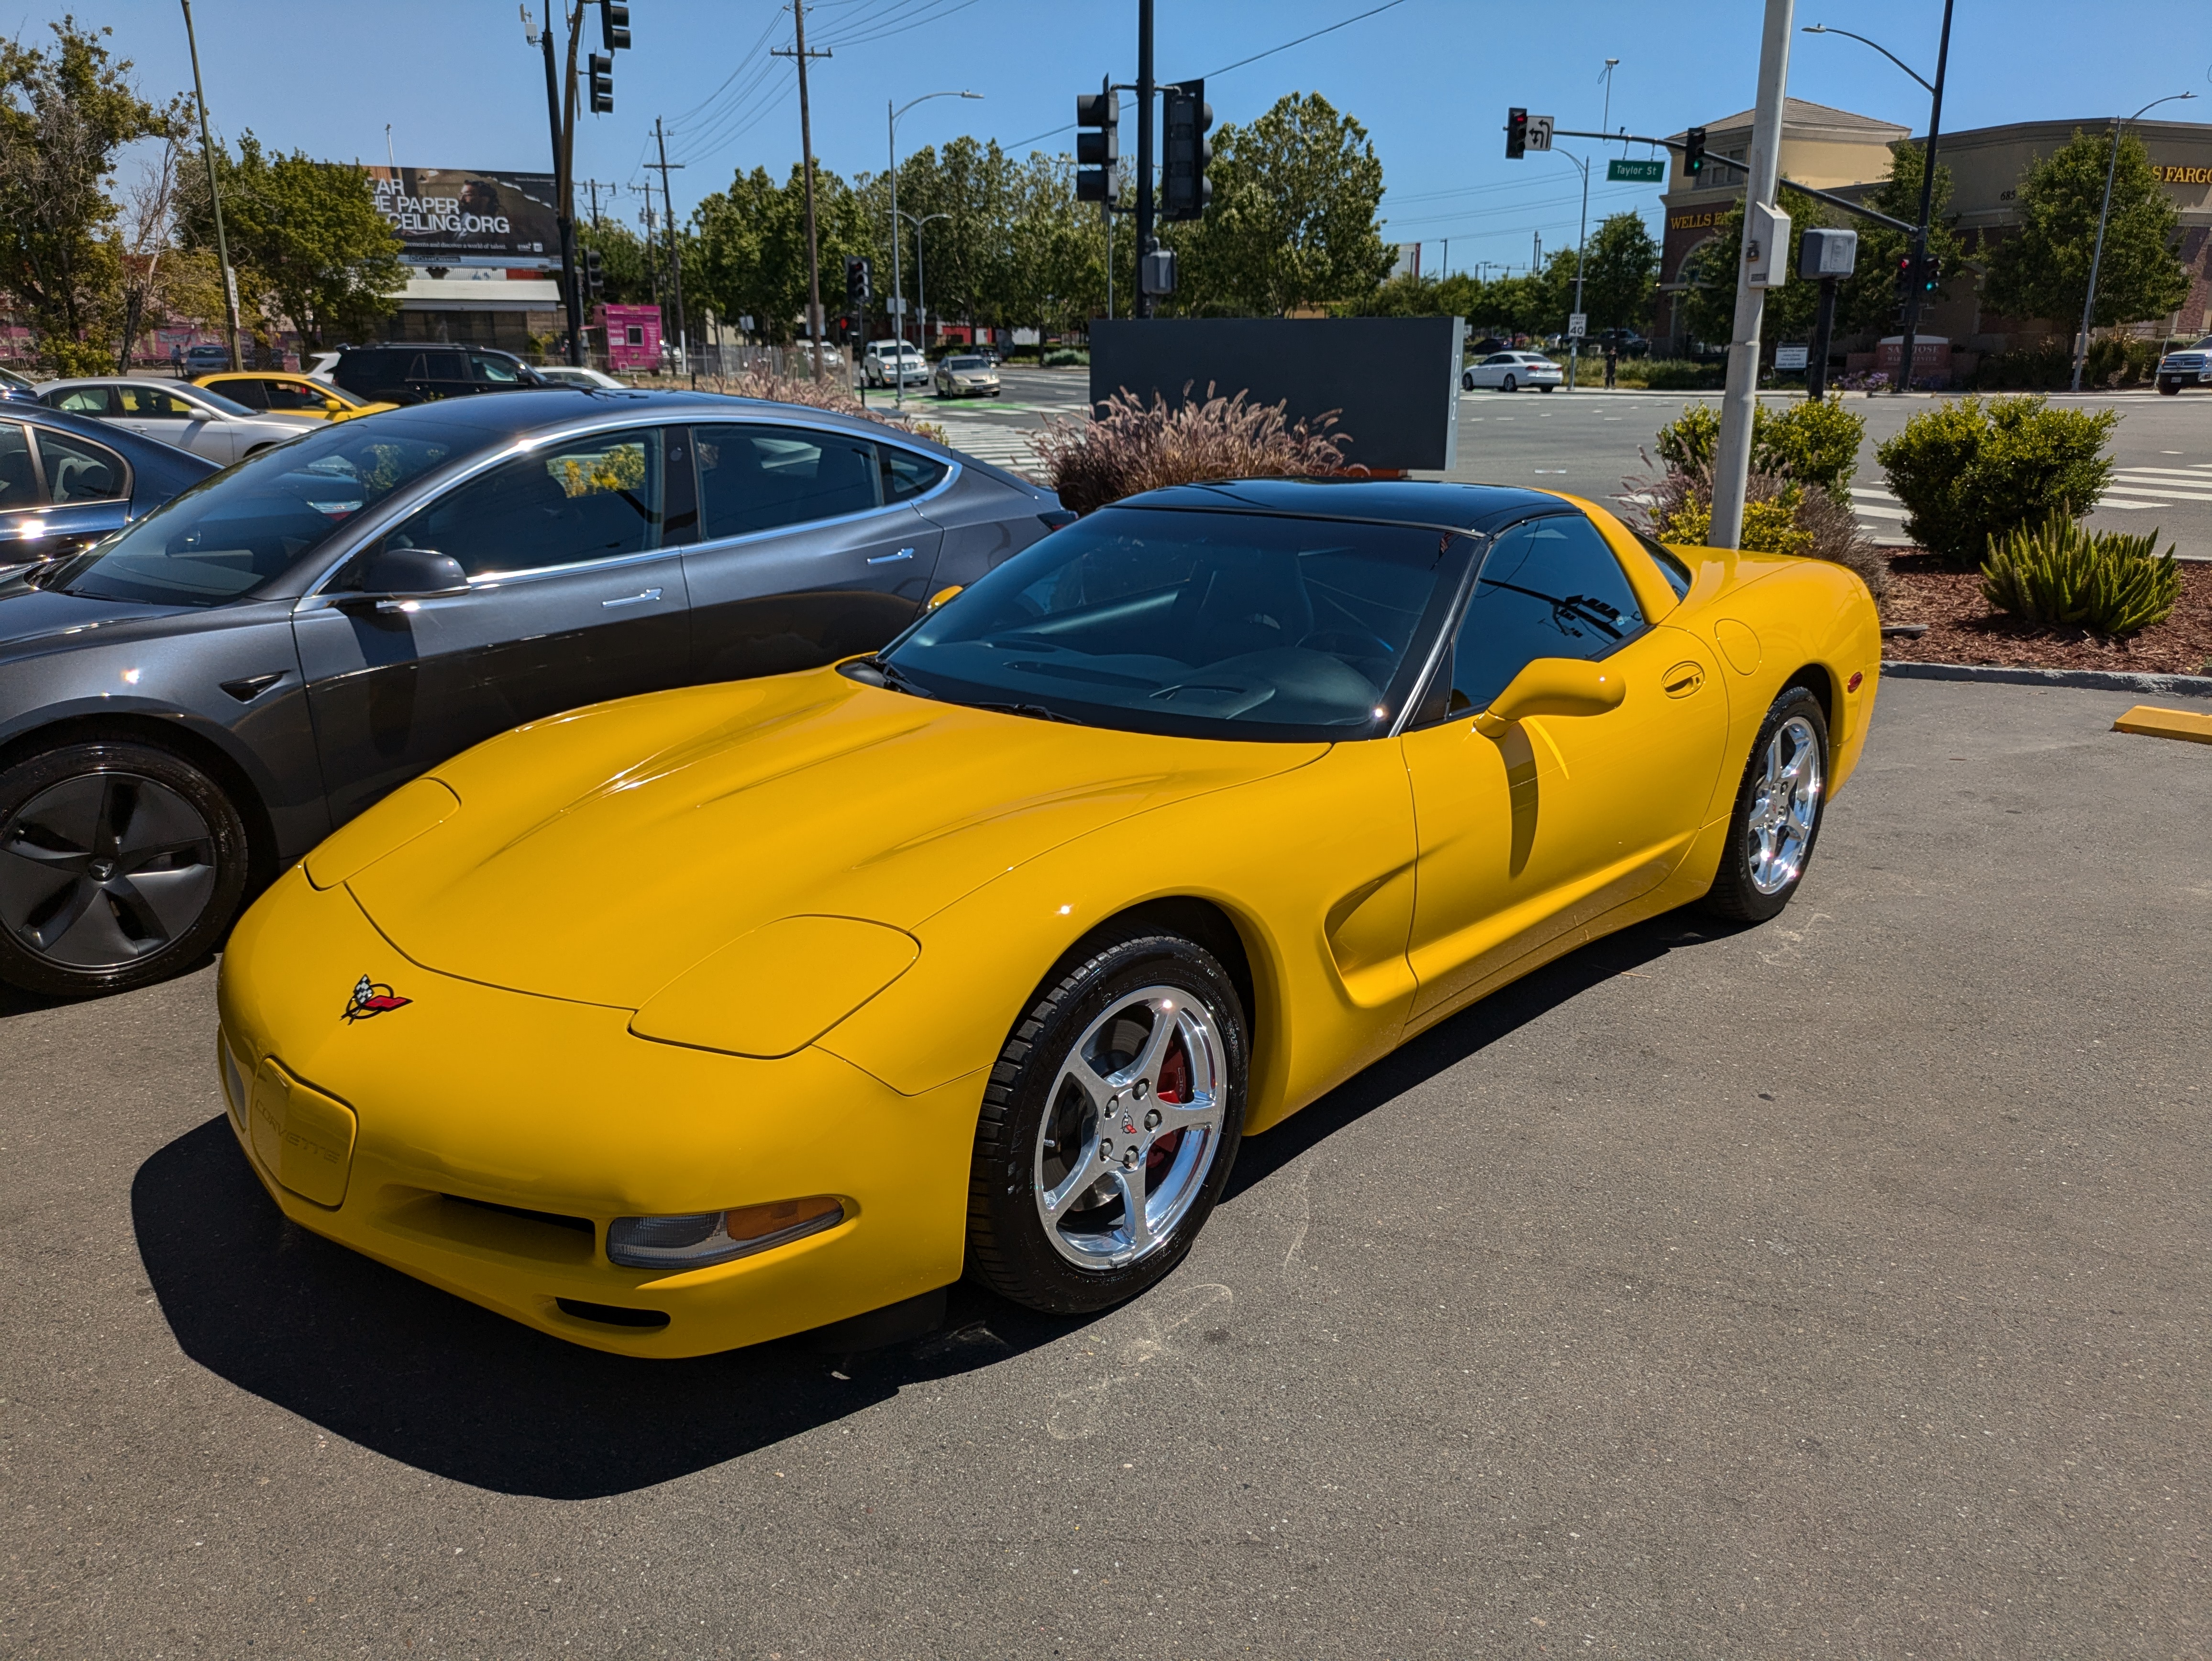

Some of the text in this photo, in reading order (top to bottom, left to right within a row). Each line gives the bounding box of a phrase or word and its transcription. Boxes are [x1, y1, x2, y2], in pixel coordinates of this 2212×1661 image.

[1617, 165, 1657, 177] Taylor St
[367, 177, 404, 195] EAR
[2001, 189, 2016, 200] 685
[370, 195, 460, 215] HE PAPER
[387, 213, 510, 233] CEILING.ORG
[1670, 213, 1712, 230] WELLS
[1570, 326, 1583, 335] 40
[1913, 345, 1939, 354] JOSE
[255, 1098, 341, 1164] CORVETTE
